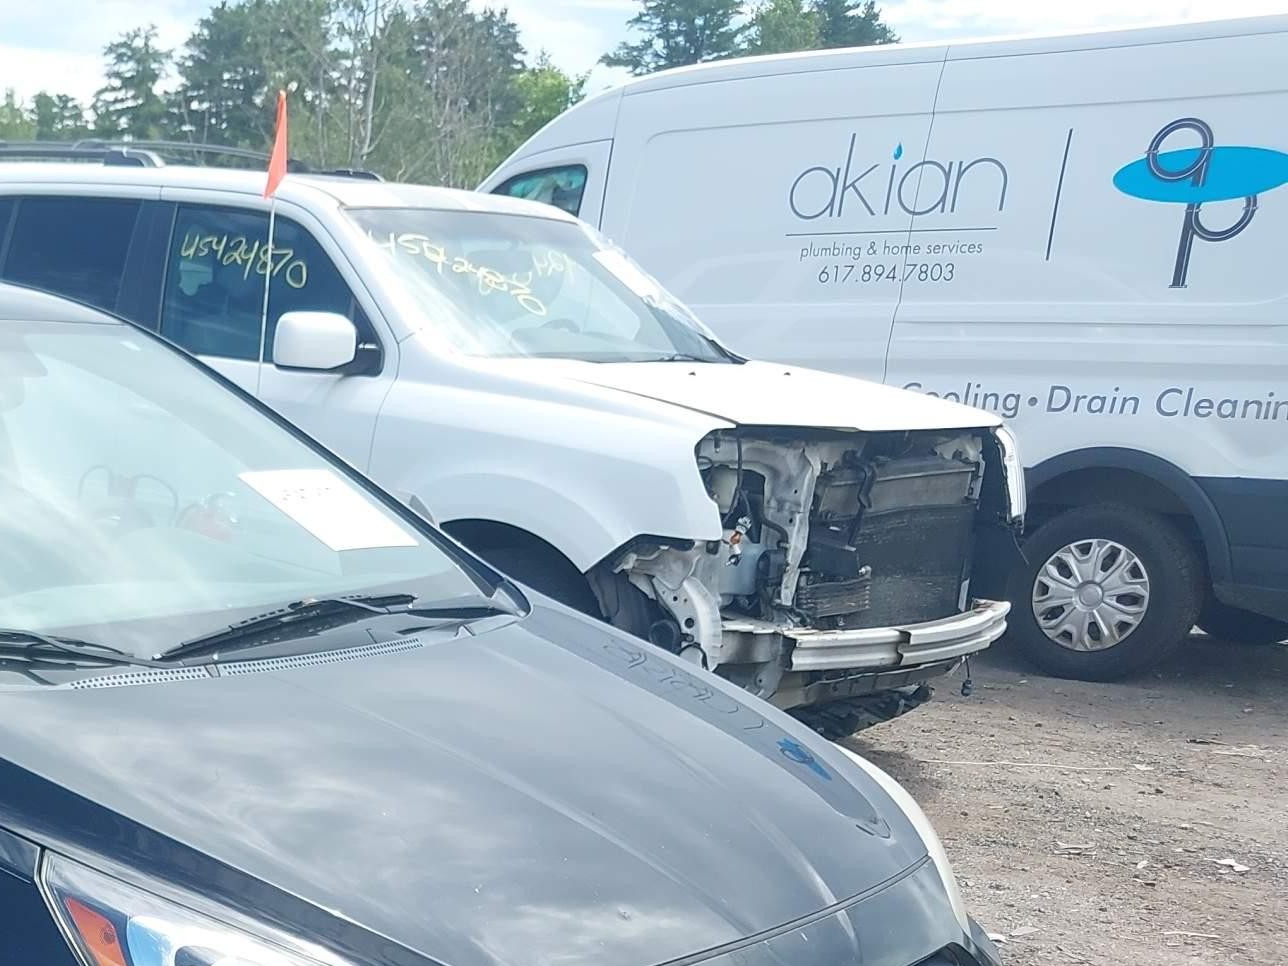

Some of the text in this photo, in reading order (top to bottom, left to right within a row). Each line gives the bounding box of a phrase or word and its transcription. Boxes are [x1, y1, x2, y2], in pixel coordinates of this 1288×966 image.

[788, 132, 1009, 220] akian
[799, 239, 984, 262] plumbing & home services
[817, 262, 956, 284] 617.894.7803
[902, 382, 1022, 419] ling
[1045, 384, 1141, 415] Drain
